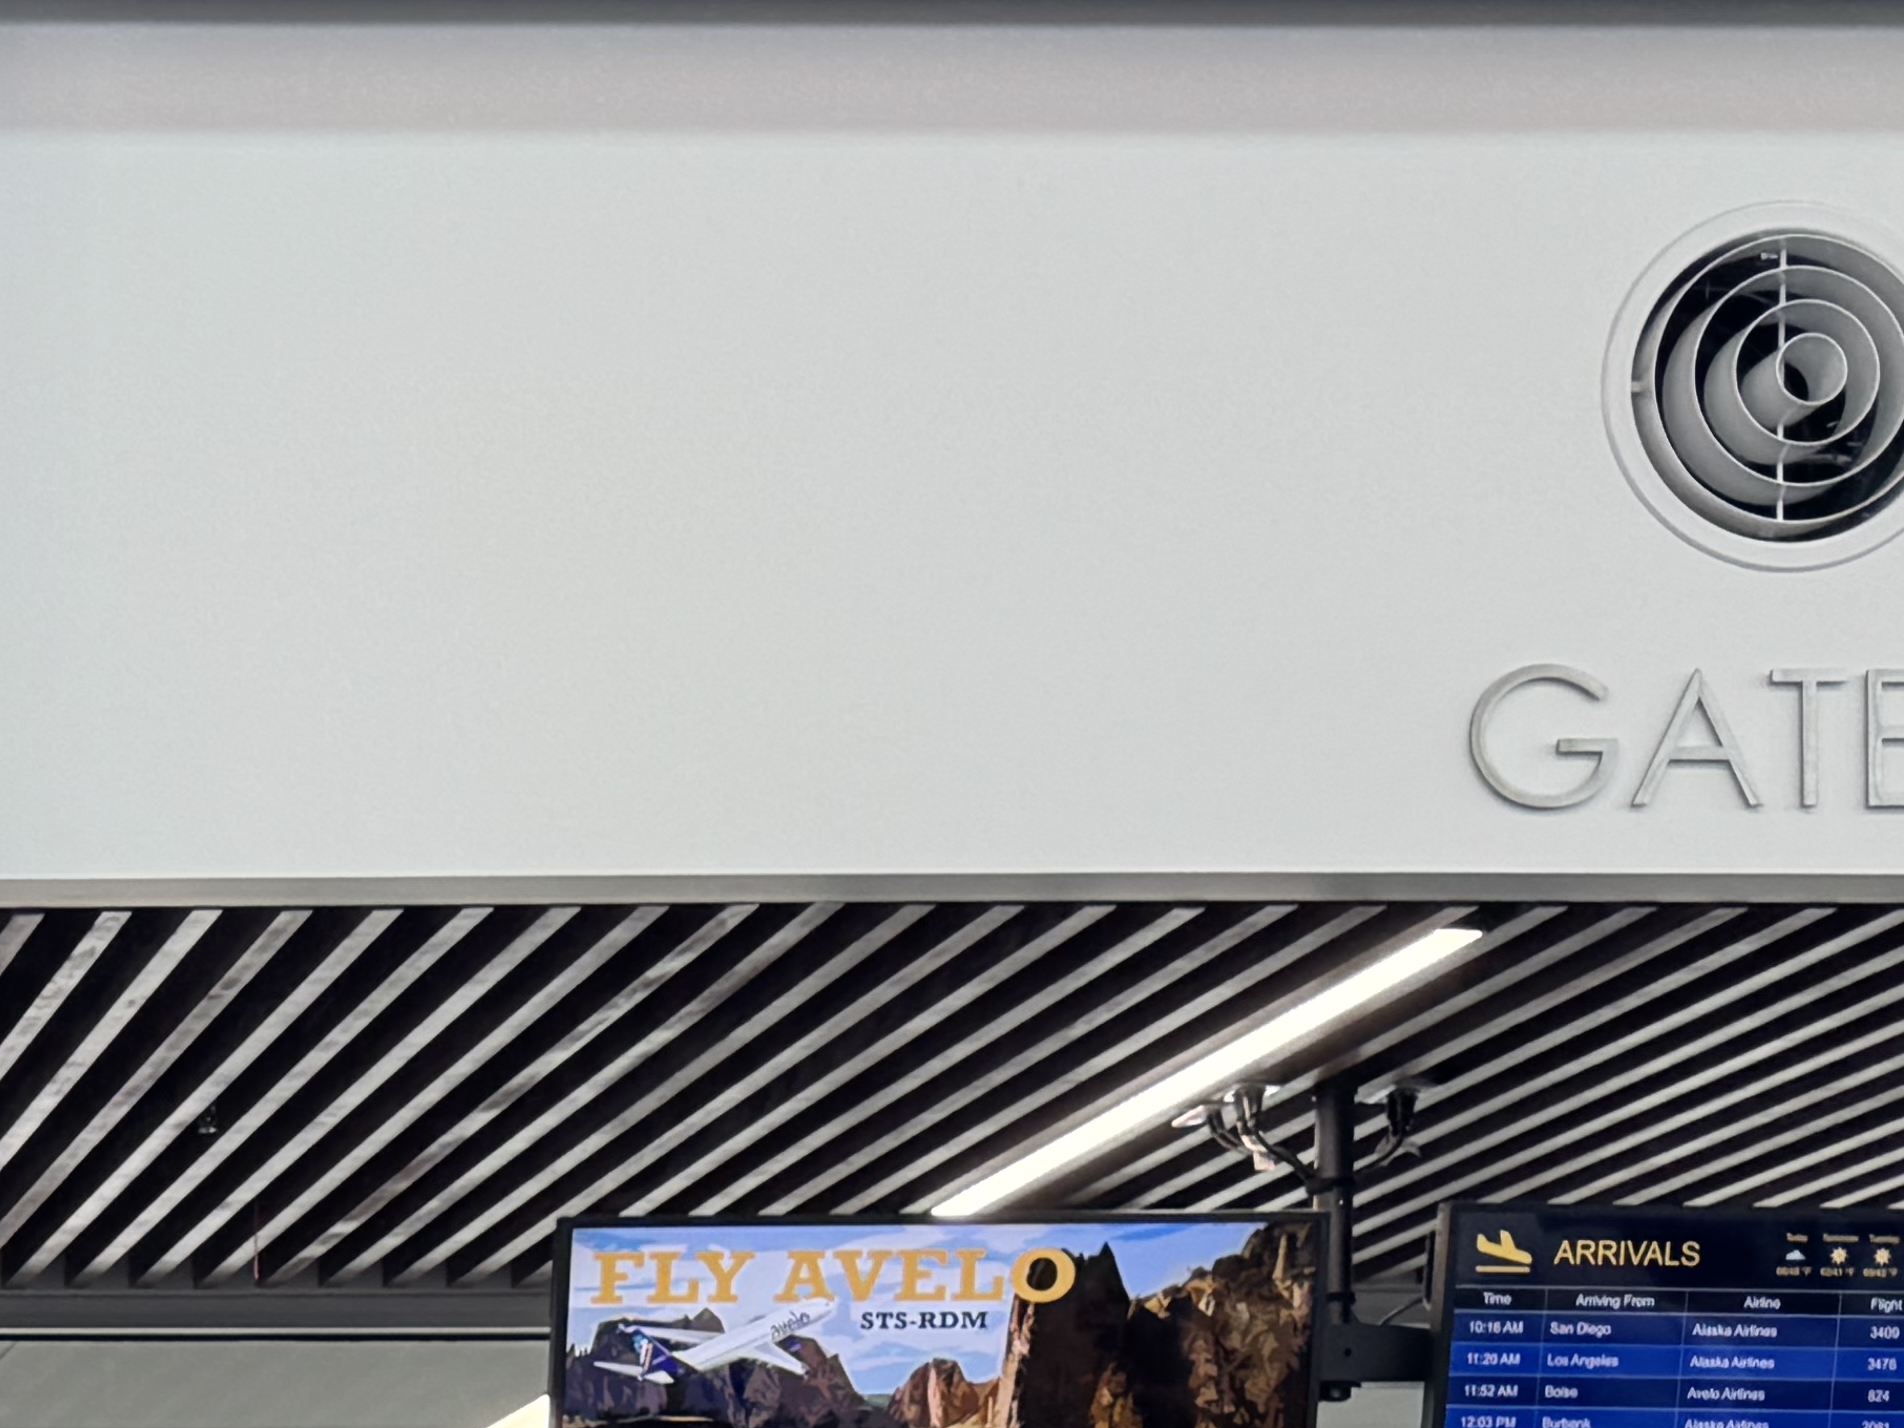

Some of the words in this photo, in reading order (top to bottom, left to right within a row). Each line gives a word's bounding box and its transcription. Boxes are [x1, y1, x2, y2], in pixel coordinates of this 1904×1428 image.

[1553, 1239, 1701, 1268] ARRIVALS
[590, 1249, 755, 1305] FLY
[773, 1246, 1077, 1304] AVELO
[1483, 1291, 1512, 1305] Time
[1575, 1294, 1620, 1309] Arriving
[1624, 1294, 1655, 1307] From
[1744, 1296, 1781, 1309] Airline
[1870, 1297, 1903, 1313] Flight
[860, 1310, 988, 1333] STS-RDM
[1502, 1321, 1524, 1334] AM
[1549, 1322, 1574, 1335] San
[1577, 1322, 1611, 1338] Diego
[1692, 1323, 1732, 1337] Alaska
[1734, 1324, 1778, 1338] Airlines
[1499, 1353, 1521, 1365] AM
[1570, 1354, 1619, 1369] Angeles
[1690, 1355, 1729, 1368] Alaska
[1731, 1356, 1775, 1369] Airlines
[1497, 1385, 1518, 1397] AM
[1544, 1385, 1578, 1398] Boise
[1721, 1387, 1765, 1401] Airlines
[1495, 1416, 1516, 1428] PM
